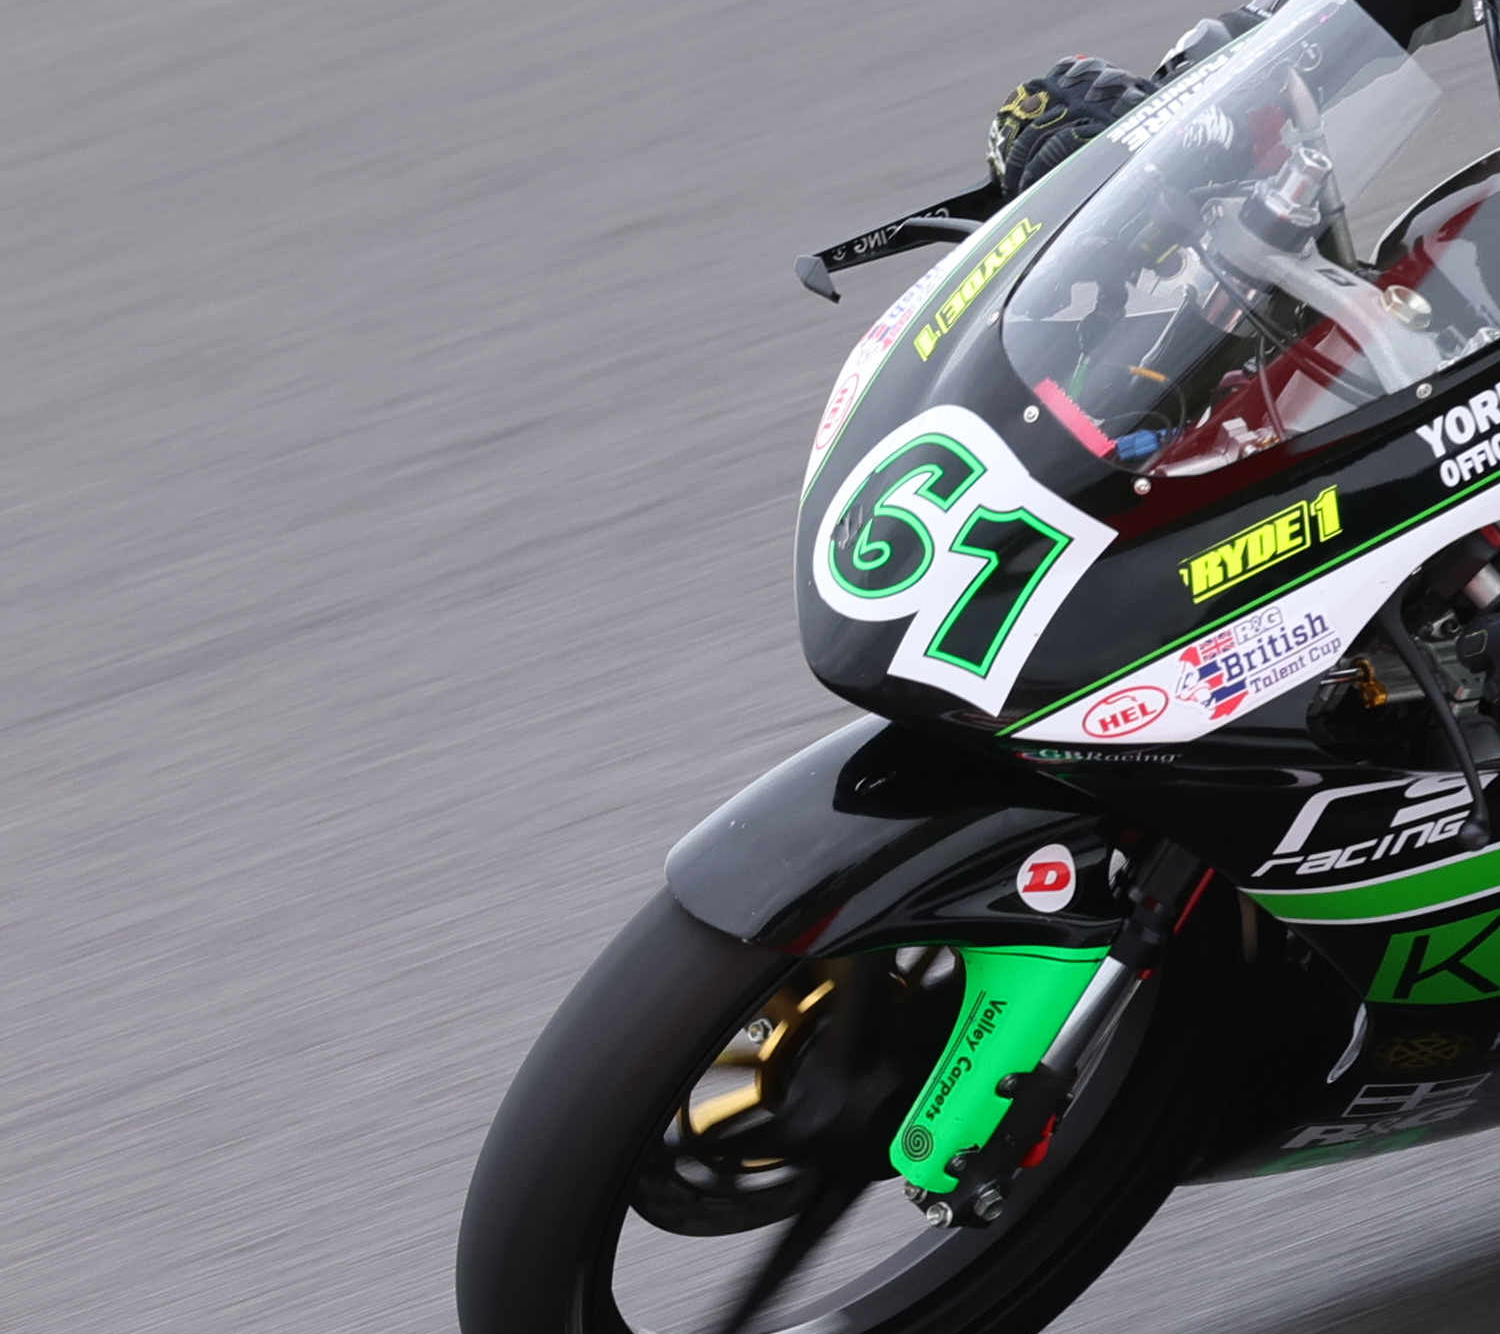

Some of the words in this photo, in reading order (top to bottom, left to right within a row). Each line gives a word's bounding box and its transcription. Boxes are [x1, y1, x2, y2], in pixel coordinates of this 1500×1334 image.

[828, 432, 1072, 679] 61
[1185, 505, 1304, 597] RYDE
[1310, 485, 1342, 543] 1
[1221, 613, 1329, 682] British
[1233, 606, 1284, 645] R&G
[1249, 656, 1307, 695] Talent
[1308, 636, 1342, 665] Cup
[1098, 700, 1158, 734] HEL
[1022, 861, 1071, 893] D
[969, 999, 1008, 1052] Valley
[925, 1054, 973, 1122] Carpets
